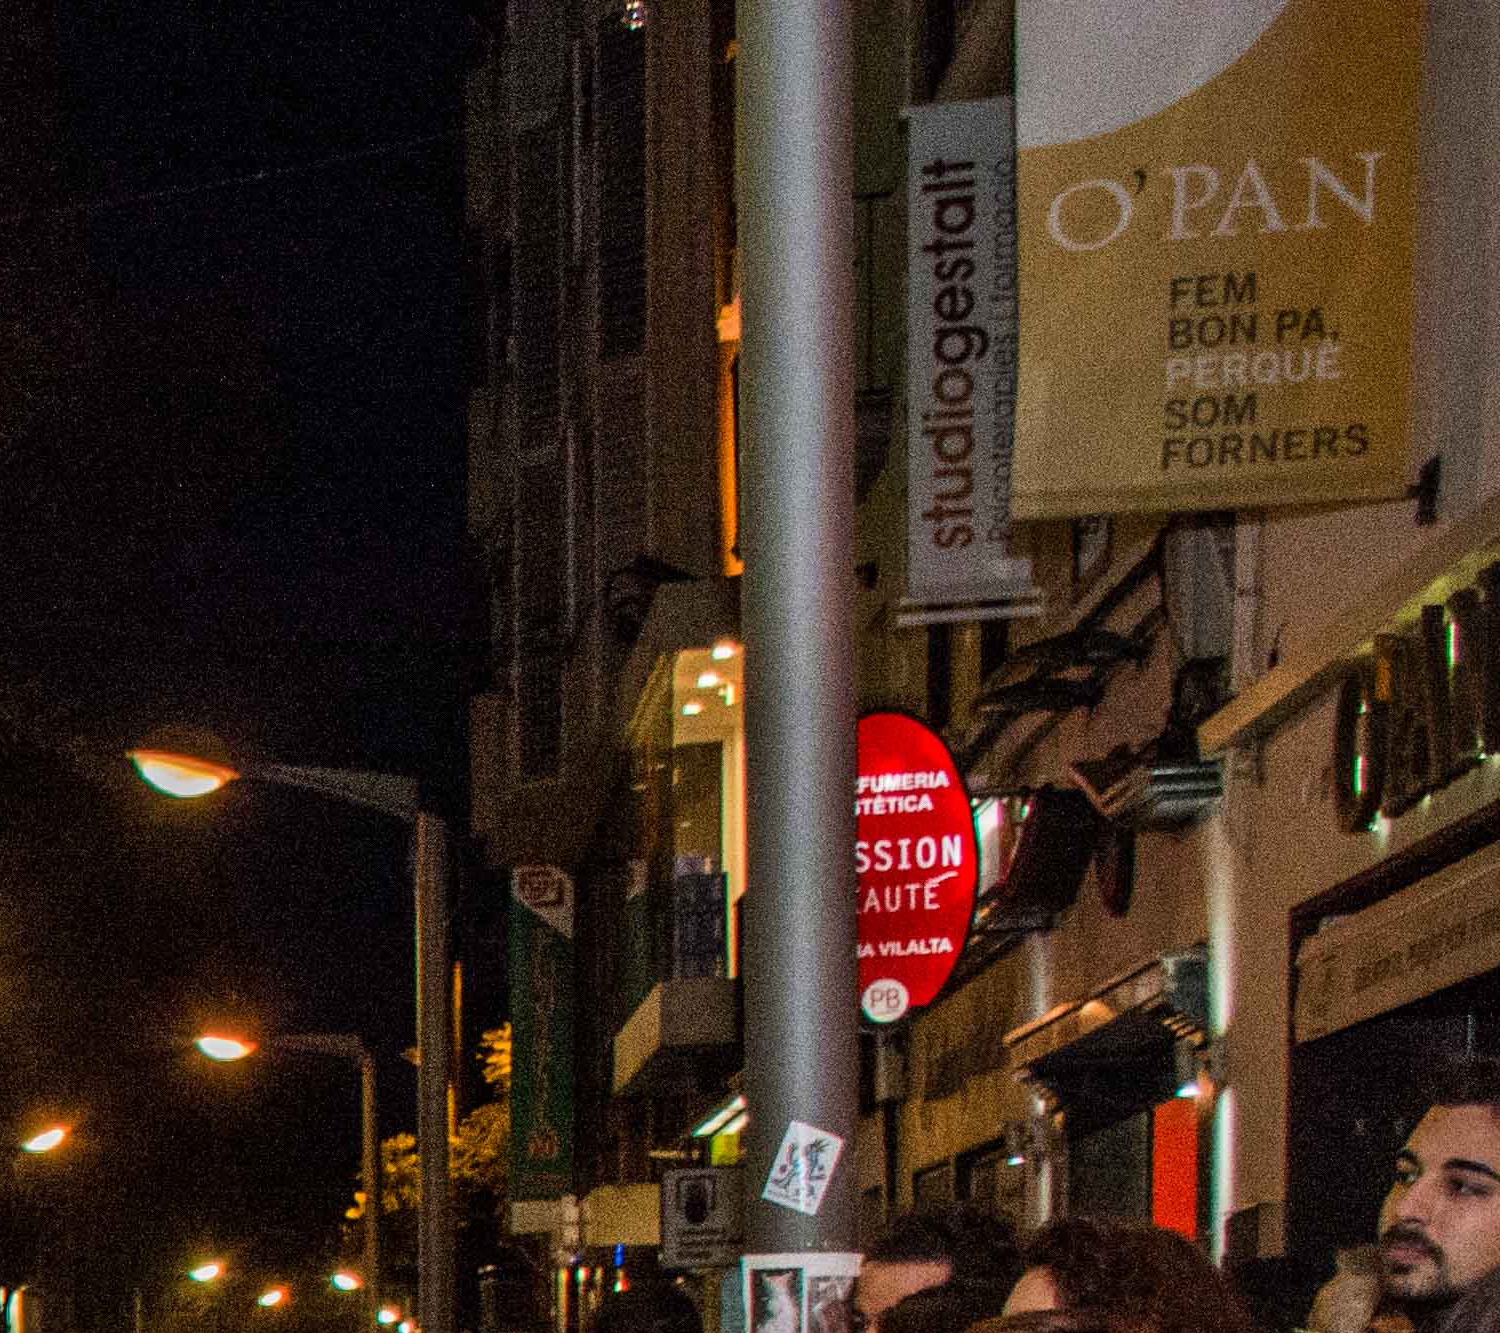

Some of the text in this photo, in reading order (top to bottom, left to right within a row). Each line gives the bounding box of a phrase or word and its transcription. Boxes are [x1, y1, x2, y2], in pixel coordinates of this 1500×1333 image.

[1168, 271, 1258, 311] FEM
[1168, 312, 1260, 351] BON
[921, 158, 989, 550] studiogestalt
[1162, 394, 1260, 432] SOM
[1160, 422, 1371, 471] FORNERS
[855, 770, 950, 795] FUMERIA
[854, 793, 934, 816] TÈTICA
[855, 870, 959, 914] AUTÉ
[879, 936, 954, 958] VILALTA
